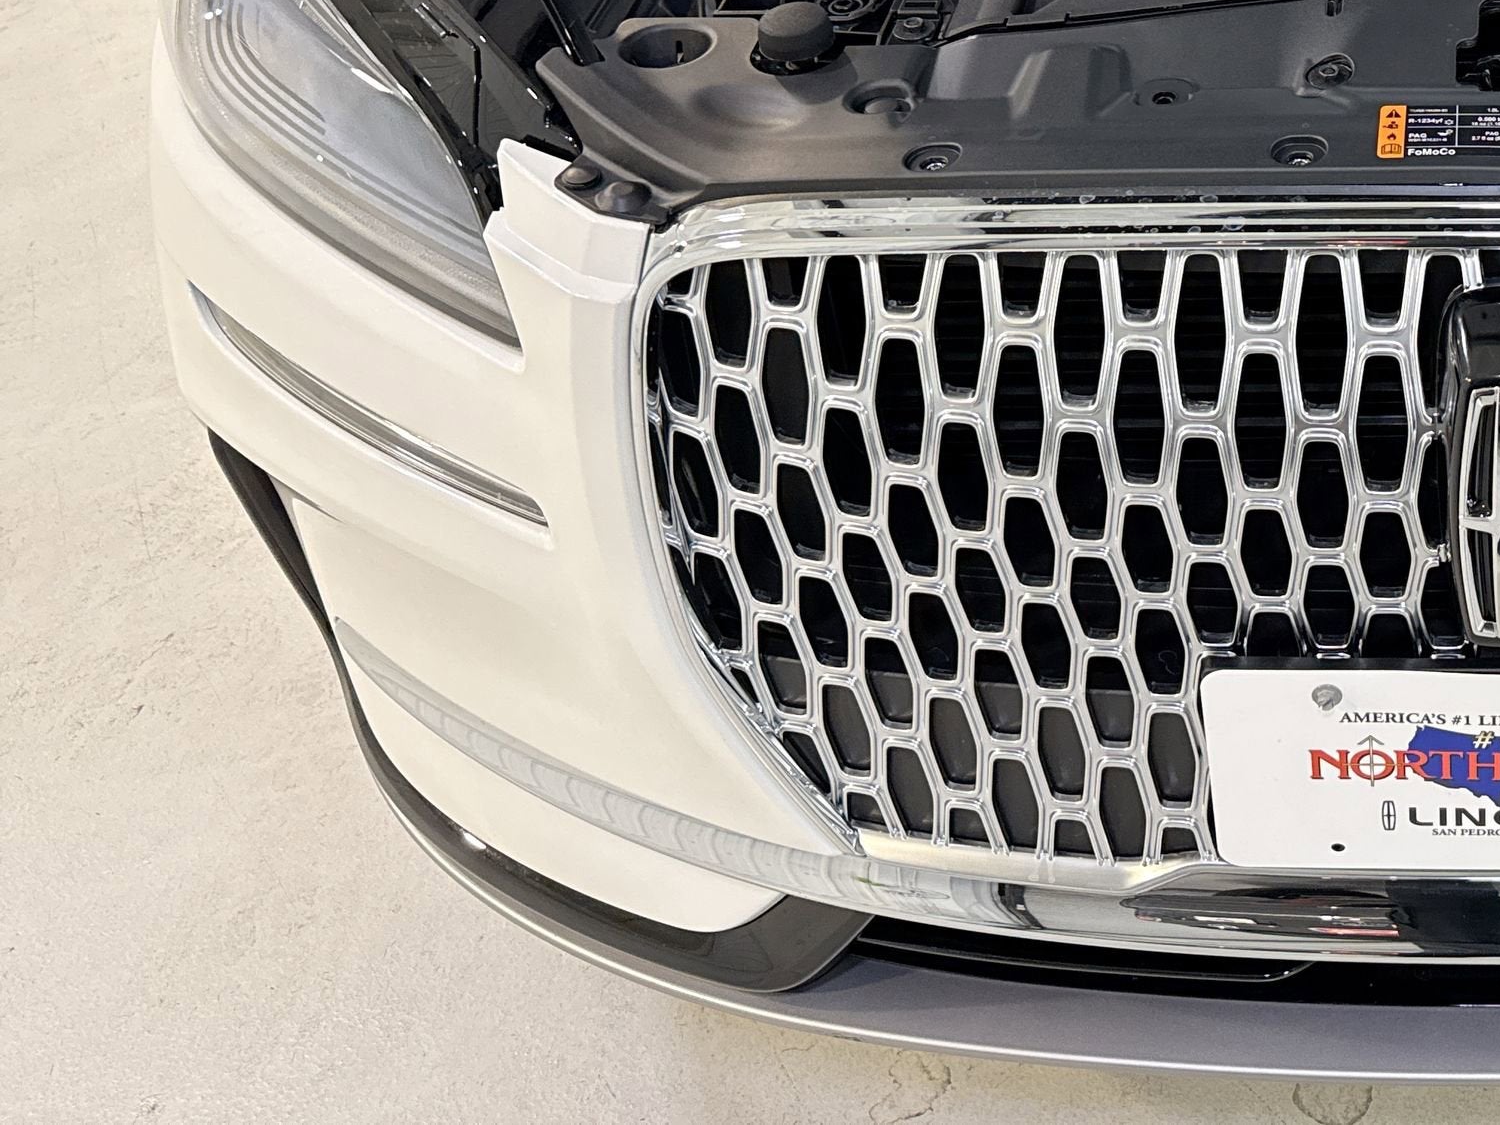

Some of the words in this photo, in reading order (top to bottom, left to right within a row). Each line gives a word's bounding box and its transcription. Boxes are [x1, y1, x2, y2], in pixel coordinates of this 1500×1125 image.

[1407, 148, 1456, 156] FoMoCo
[1339, 711, 1447, 725] AMERICA'S
[1450, 715, 1471, 726] #1
[1431, 827, 1458, 837] SAN
